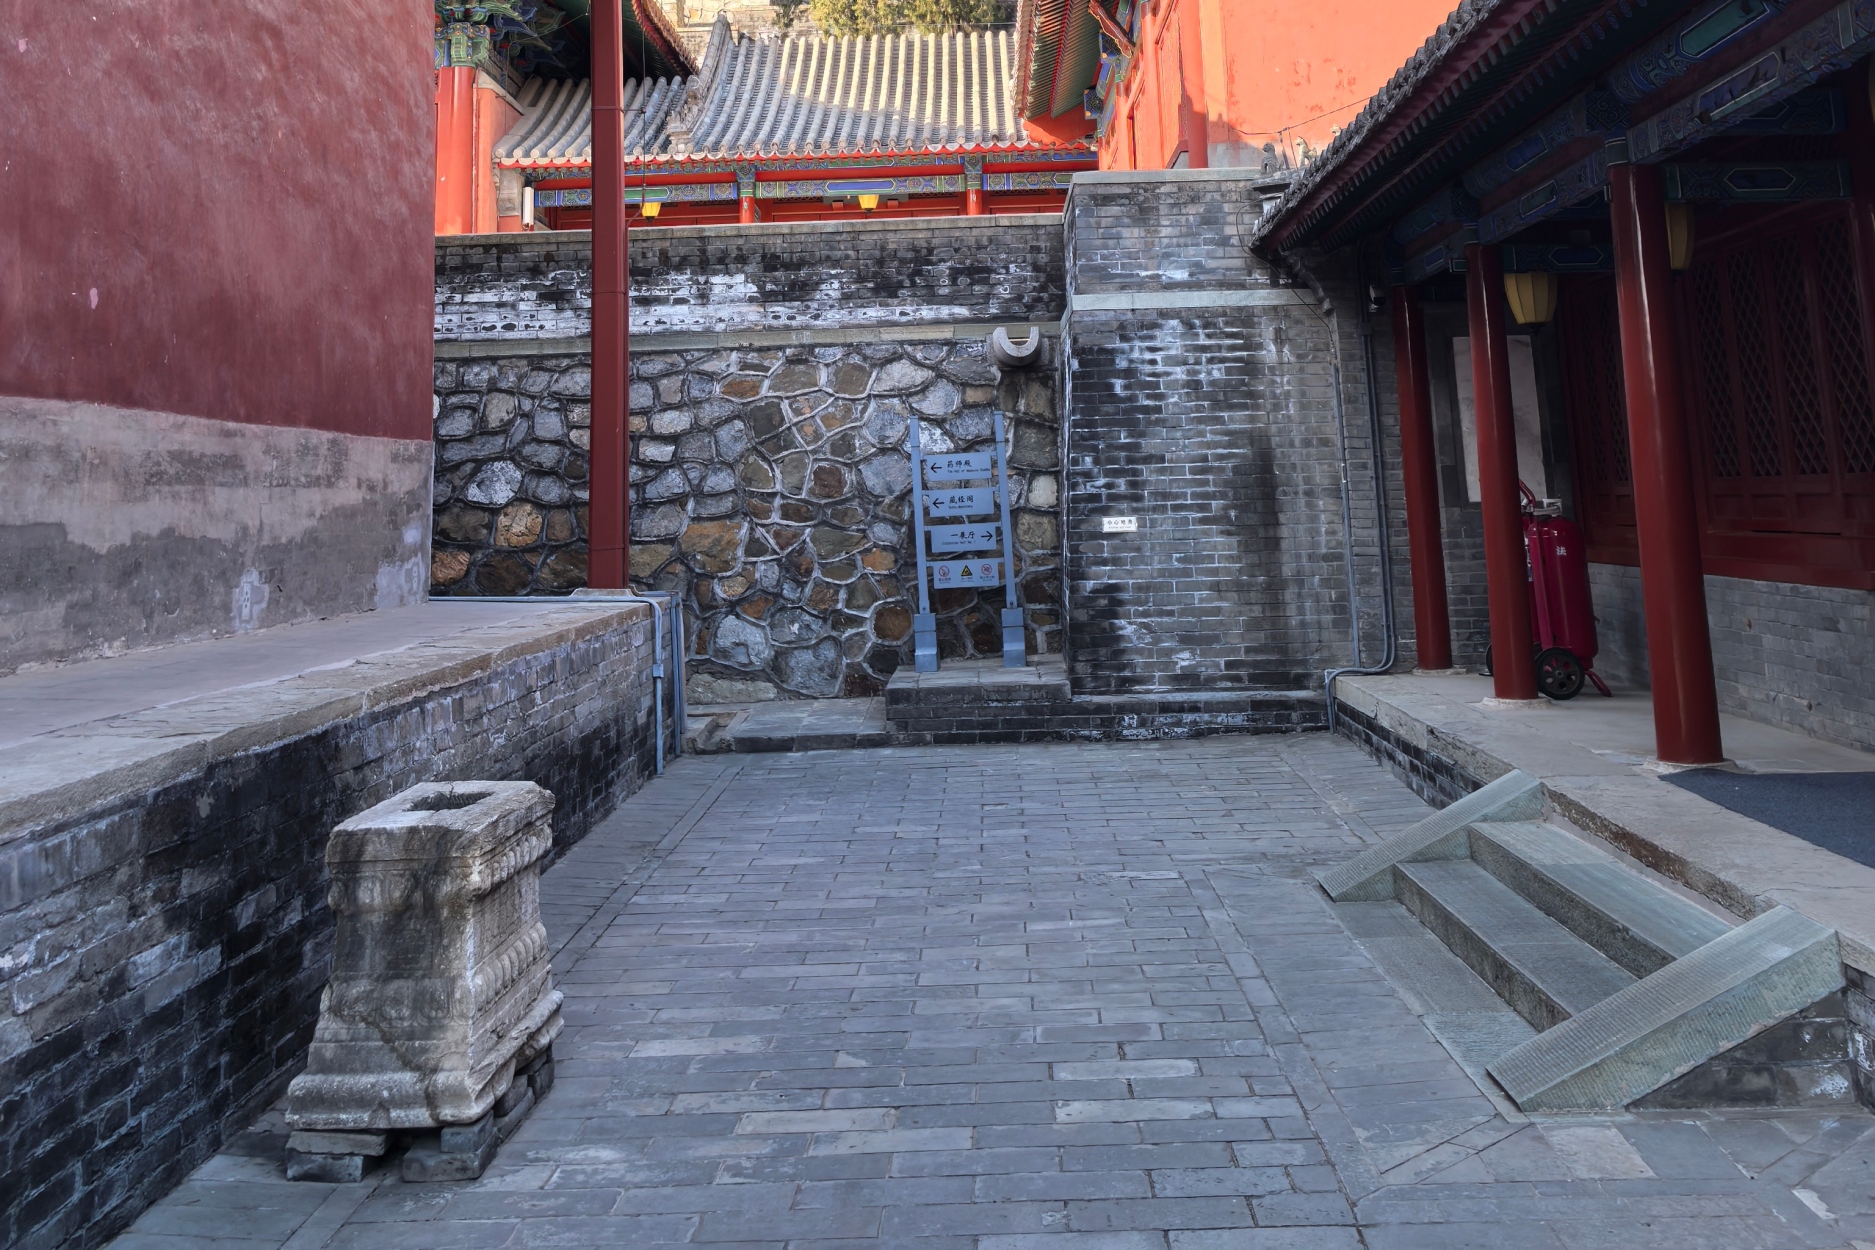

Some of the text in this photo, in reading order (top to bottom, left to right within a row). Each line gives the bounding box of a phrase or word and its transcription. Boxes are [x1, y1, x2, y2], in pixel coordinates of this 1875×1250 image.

[947, 459, 972, 468] 药师殿
[949, 494, 974, 504] 藏经阁
[950, 530, 975, 540] 一展厅
